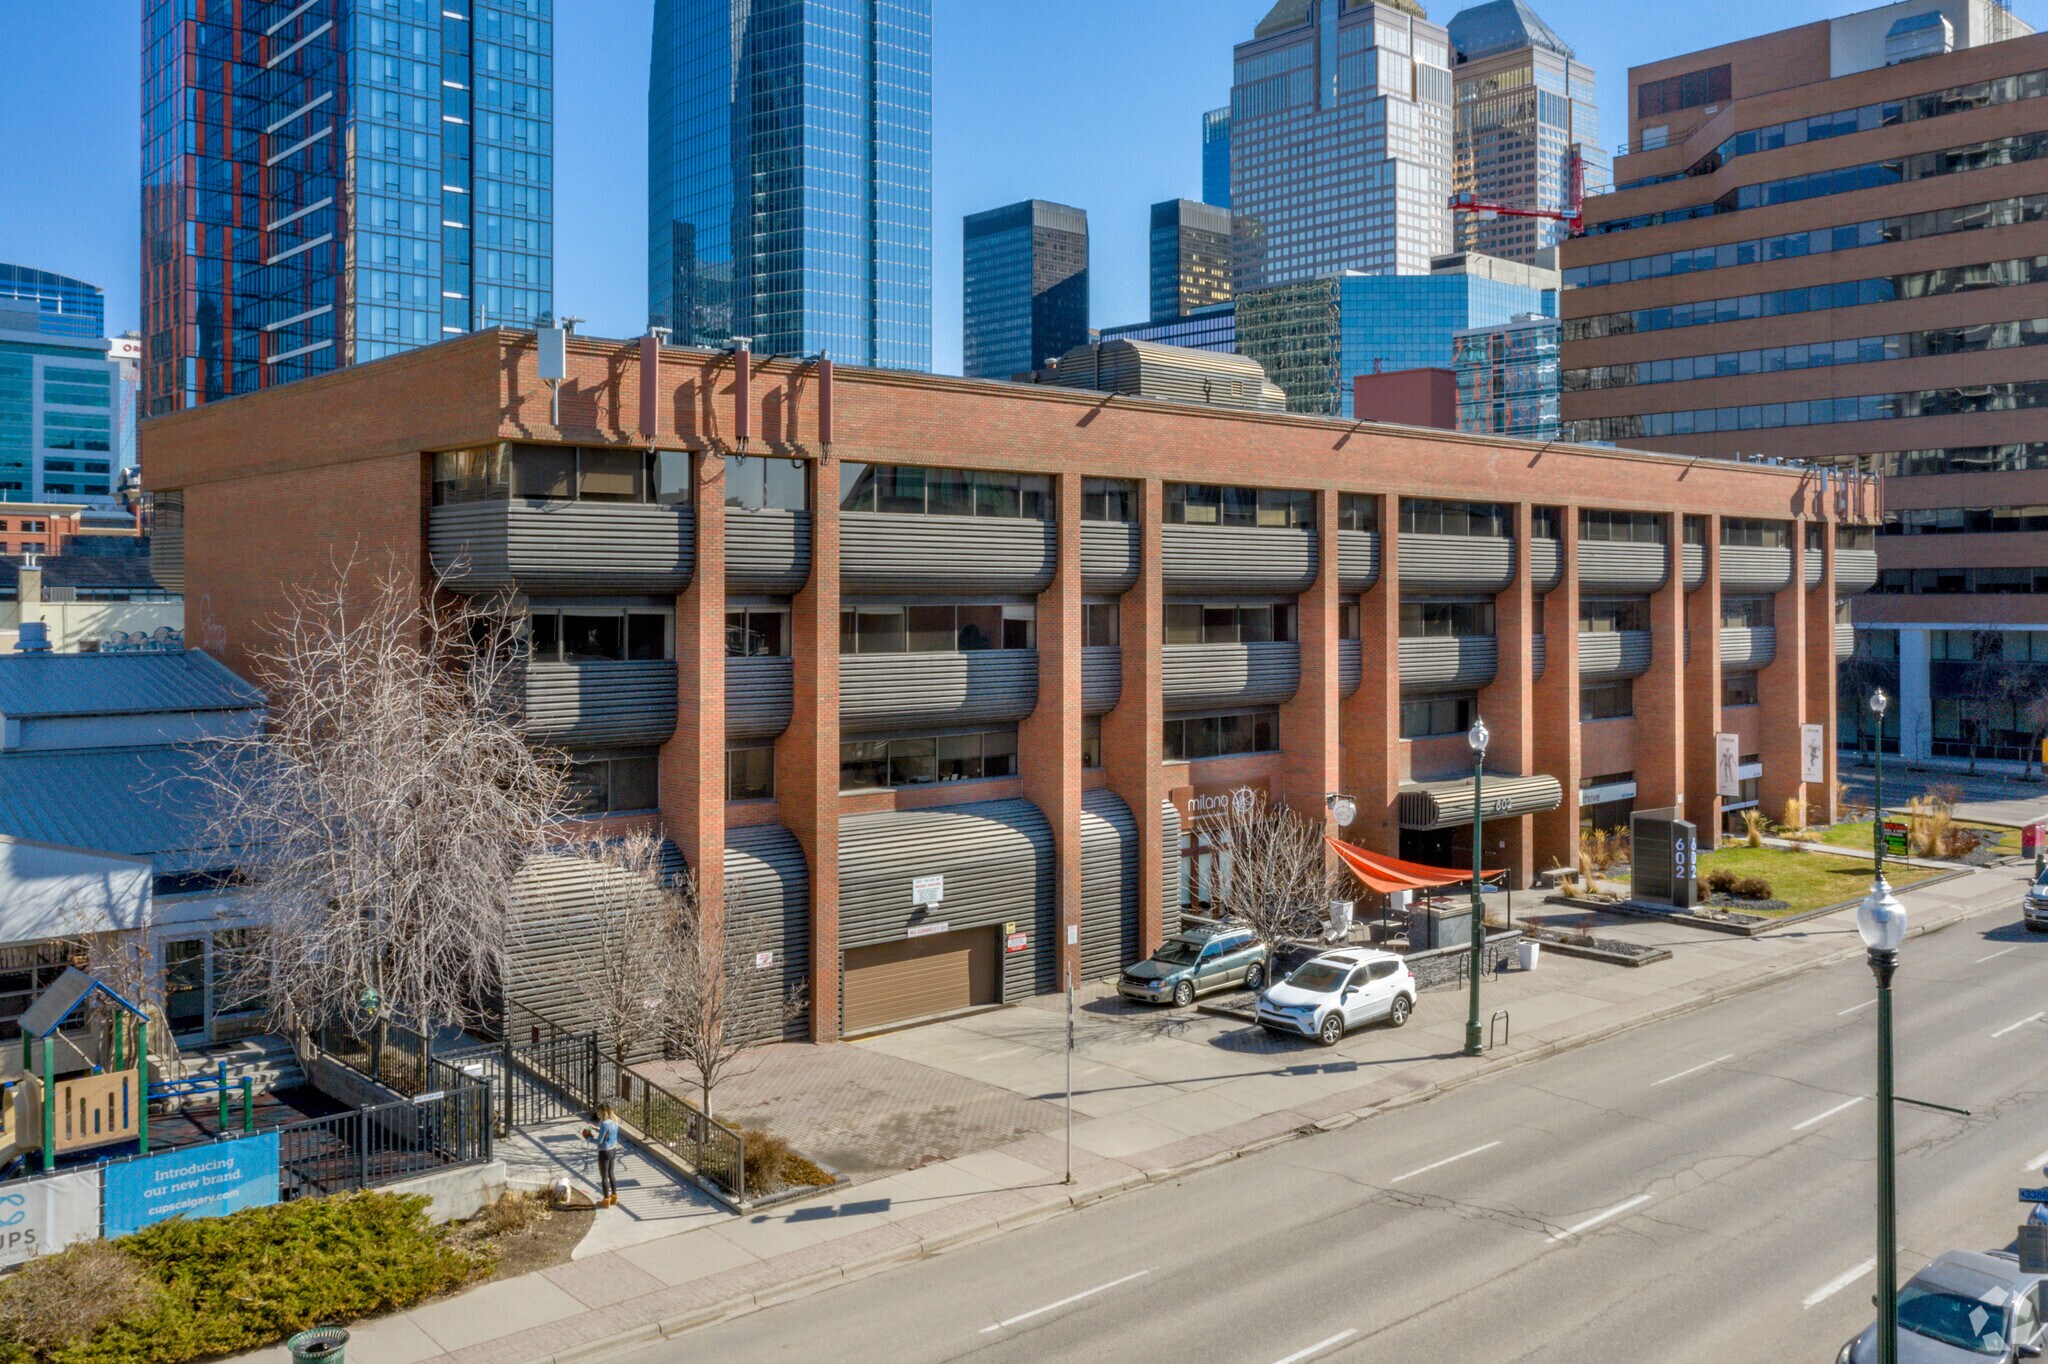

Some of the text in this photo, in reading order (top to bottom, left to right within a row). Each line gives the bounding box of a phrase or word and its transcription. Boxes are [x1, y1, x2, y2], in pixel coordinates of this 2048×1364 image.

[1187, 793, 1229, 812] milano
[1495, 797, 1512, 811] 602
[1675, 837, 1685, 879] 602
[155, 1158, 235, 1182] Introducing
[143, 1168, 244, 1199] our new brand.
[148, 1189, 240, 1216] cupscalgary.com
